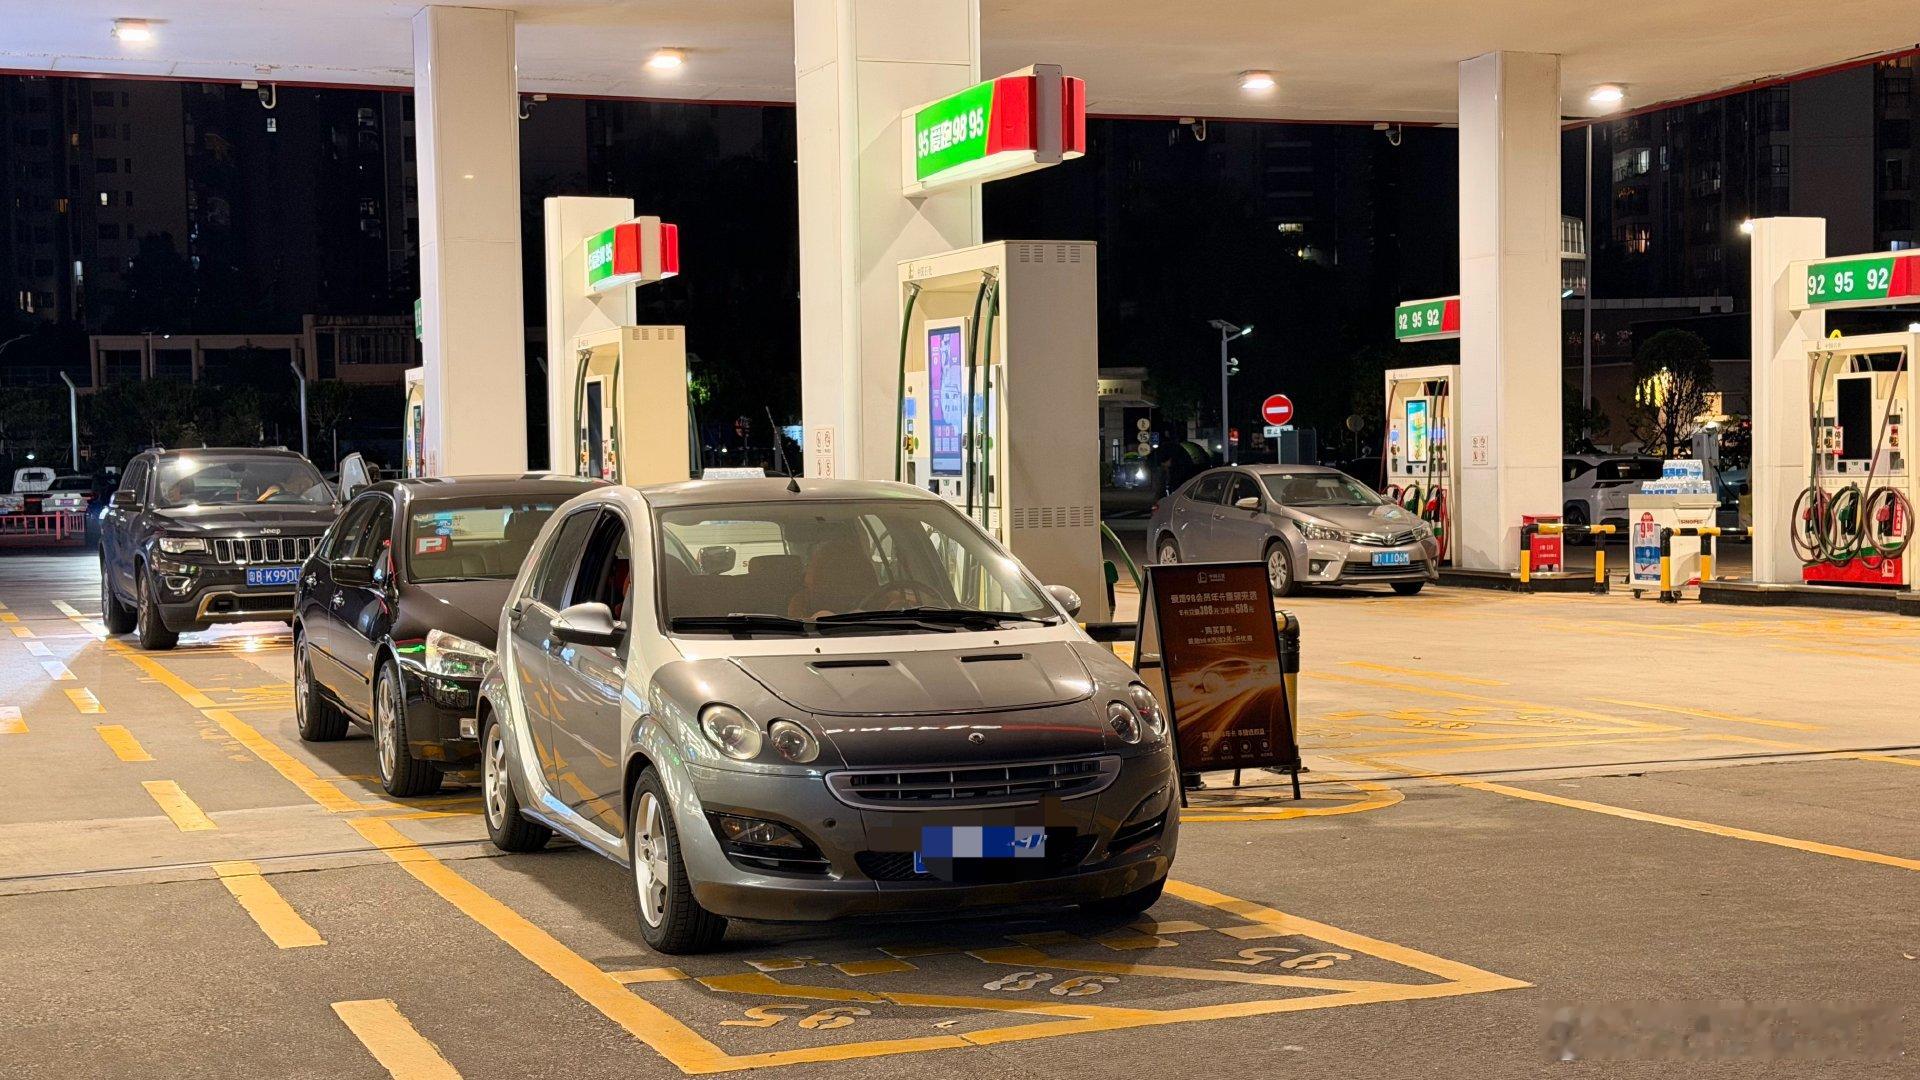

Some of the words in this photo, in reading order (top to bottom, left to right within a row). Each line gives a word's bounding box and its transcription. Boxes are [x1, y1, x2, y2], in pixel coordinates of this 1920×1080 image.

[918, 129, 930, 159] 95
[968, 107, 984, 139] 95
[1807, 274, 1826, 296] 92
[1834, 271, 1854, 293] 95
[1867, 267, 1888, 290] 92
[1399, 313, 1408, 330] 92
[1412, 311, 1422, 328] 95
[1427, 309, 1439, 326] 92
